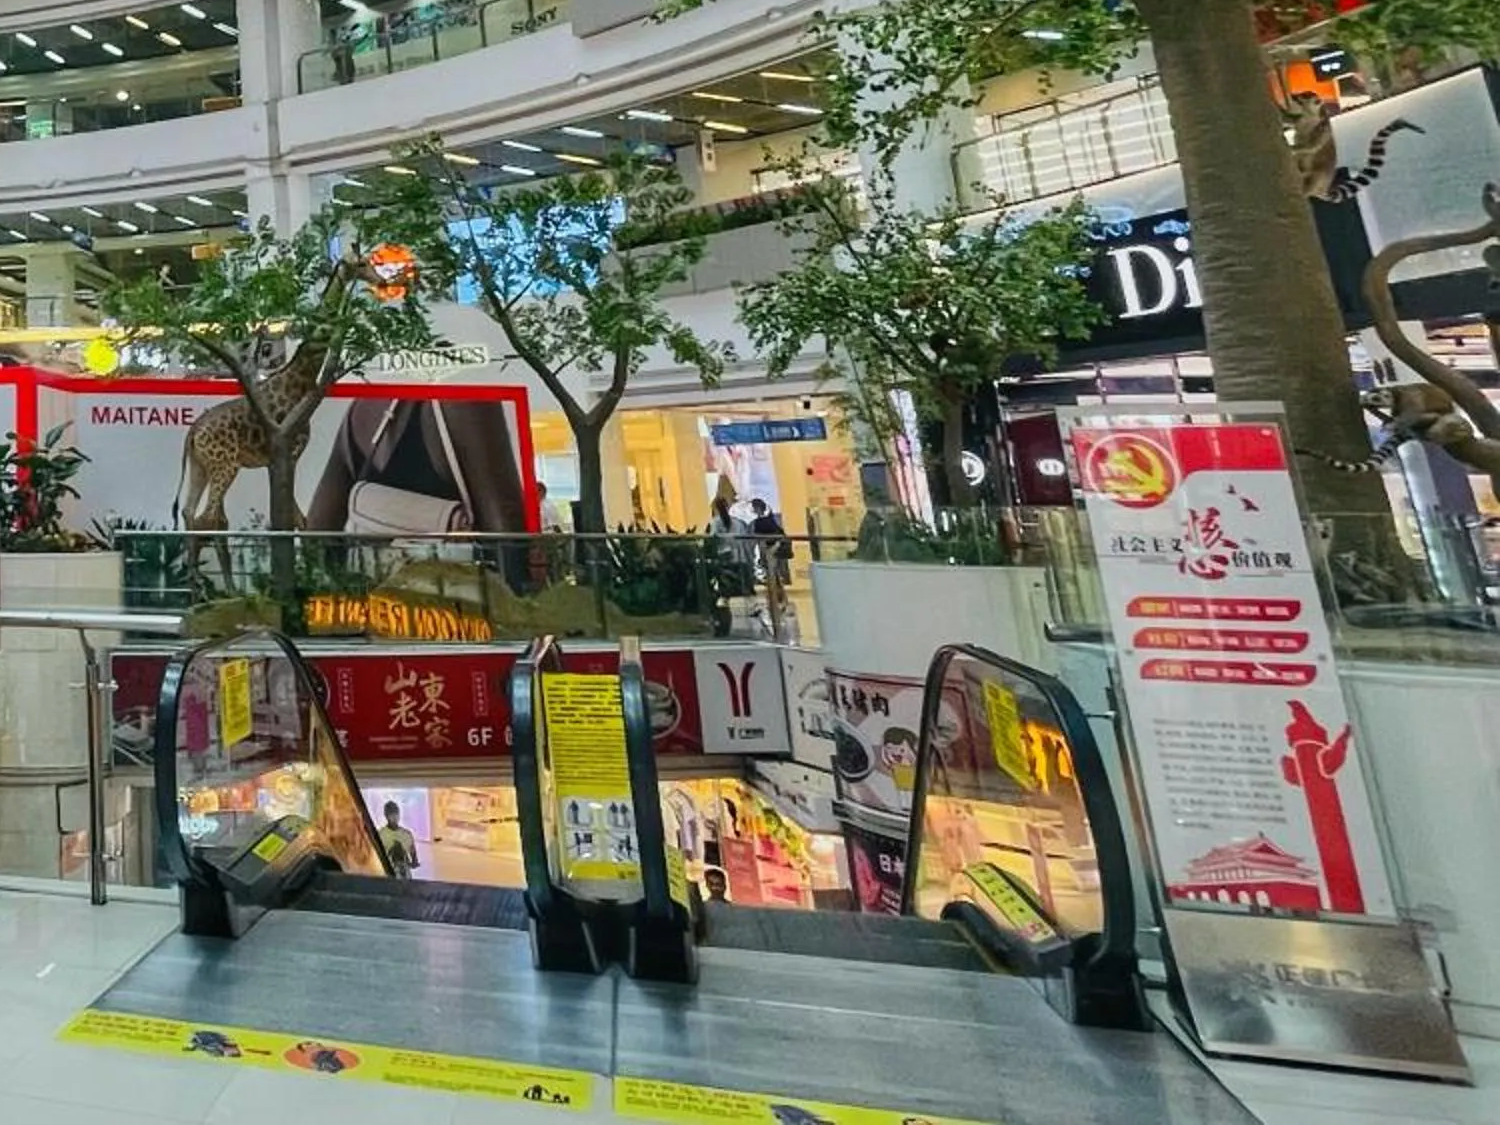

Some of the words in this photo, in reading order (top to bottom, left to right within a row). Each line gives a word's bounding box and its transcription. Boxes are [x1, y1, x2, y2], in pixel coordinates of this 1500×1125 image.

[511, 5, 558, 35] SONY
[1107, 237, 1203, 319] Di
[91, 406, 194, 426] MAITANE
[467, 727, 493, 746] 6F
